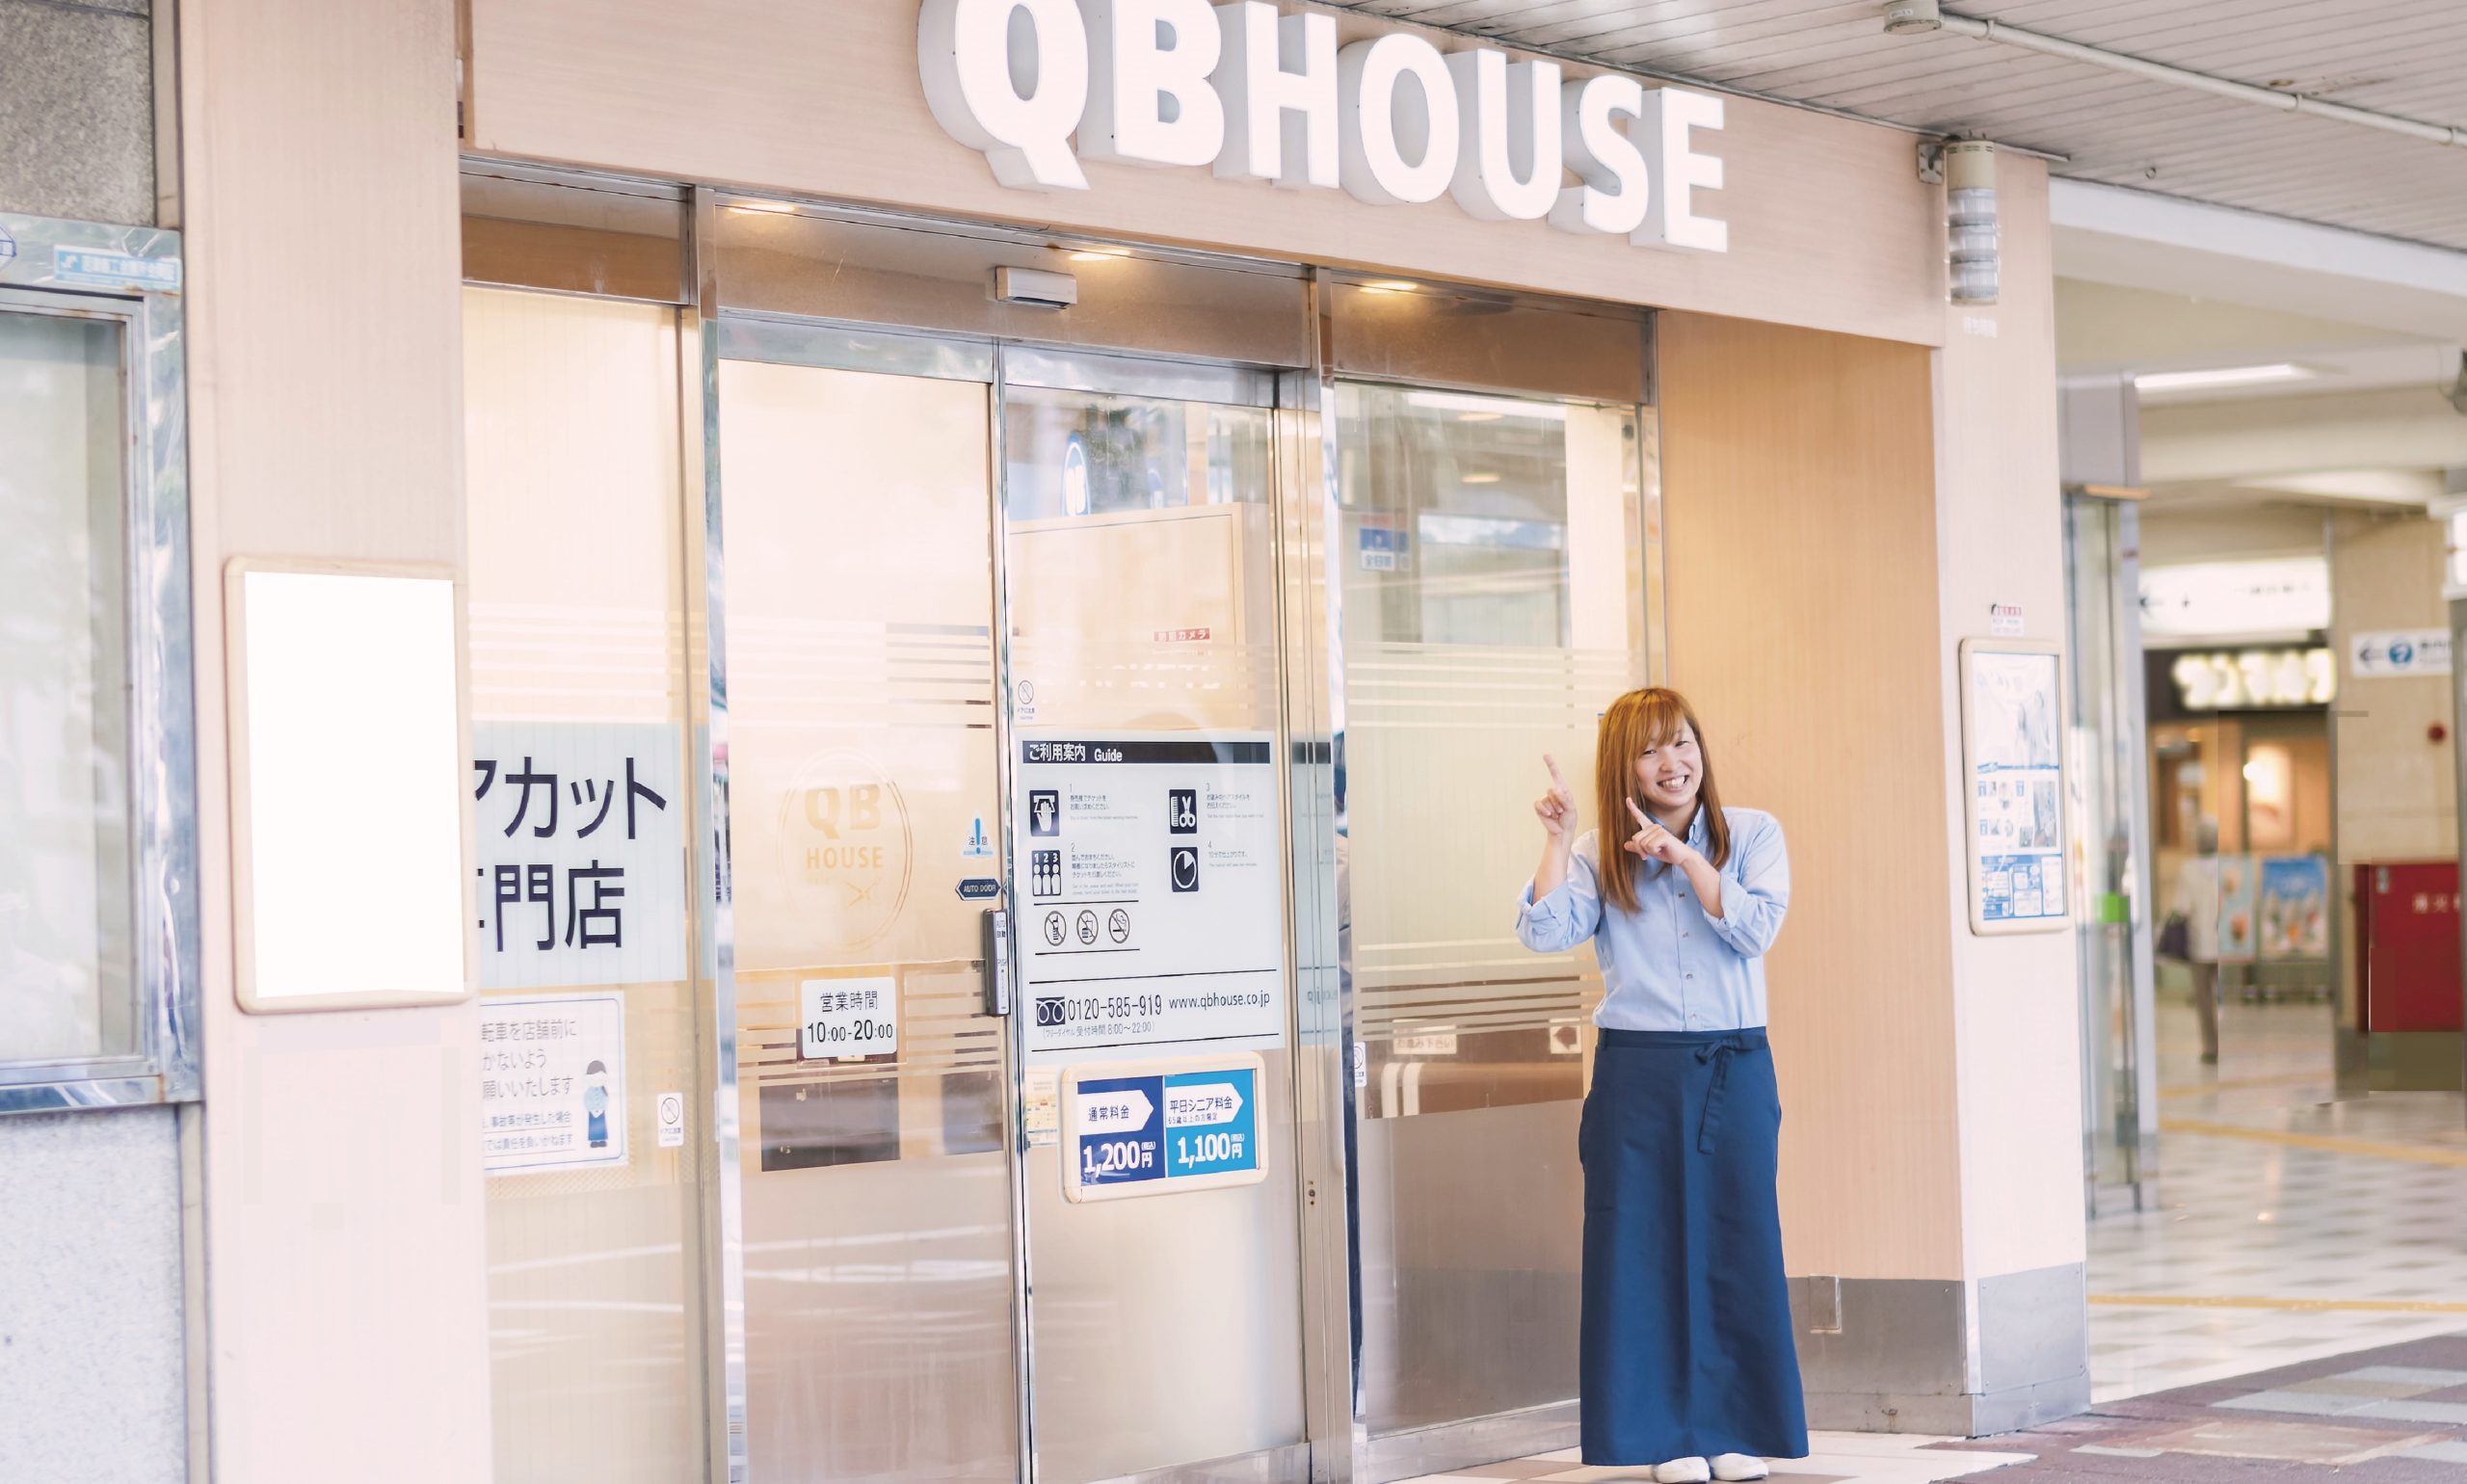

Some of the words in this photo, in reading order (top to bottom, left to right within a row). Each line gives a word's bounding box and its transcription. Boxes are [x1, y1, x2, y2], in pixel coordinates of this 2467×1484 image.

[1029, 742, 1086, 762] ご利用案内
[1094, 748, 1123, 762] Guide
[805, 783, 881, 839] QB
[806, 846, 884, 869] HOUSE
[964, 885, 979, 893] AUTO
[980, 884, 996, 892] DOOR
[477, 859, 625, 953] 門店
[820, 991, 878, 1013] 営業時間
[1068, 994, 1162, 1021] 0120-585-919
[1168, 989, 1270, 1011] www.qbhouse.co.jp
[808, 1019, 893, 1044] 10:00-20:00
[1088, 1104, 1129, 1122] 通常料金
[1170, 1096, 1233, 1114] 平日シニア料金
